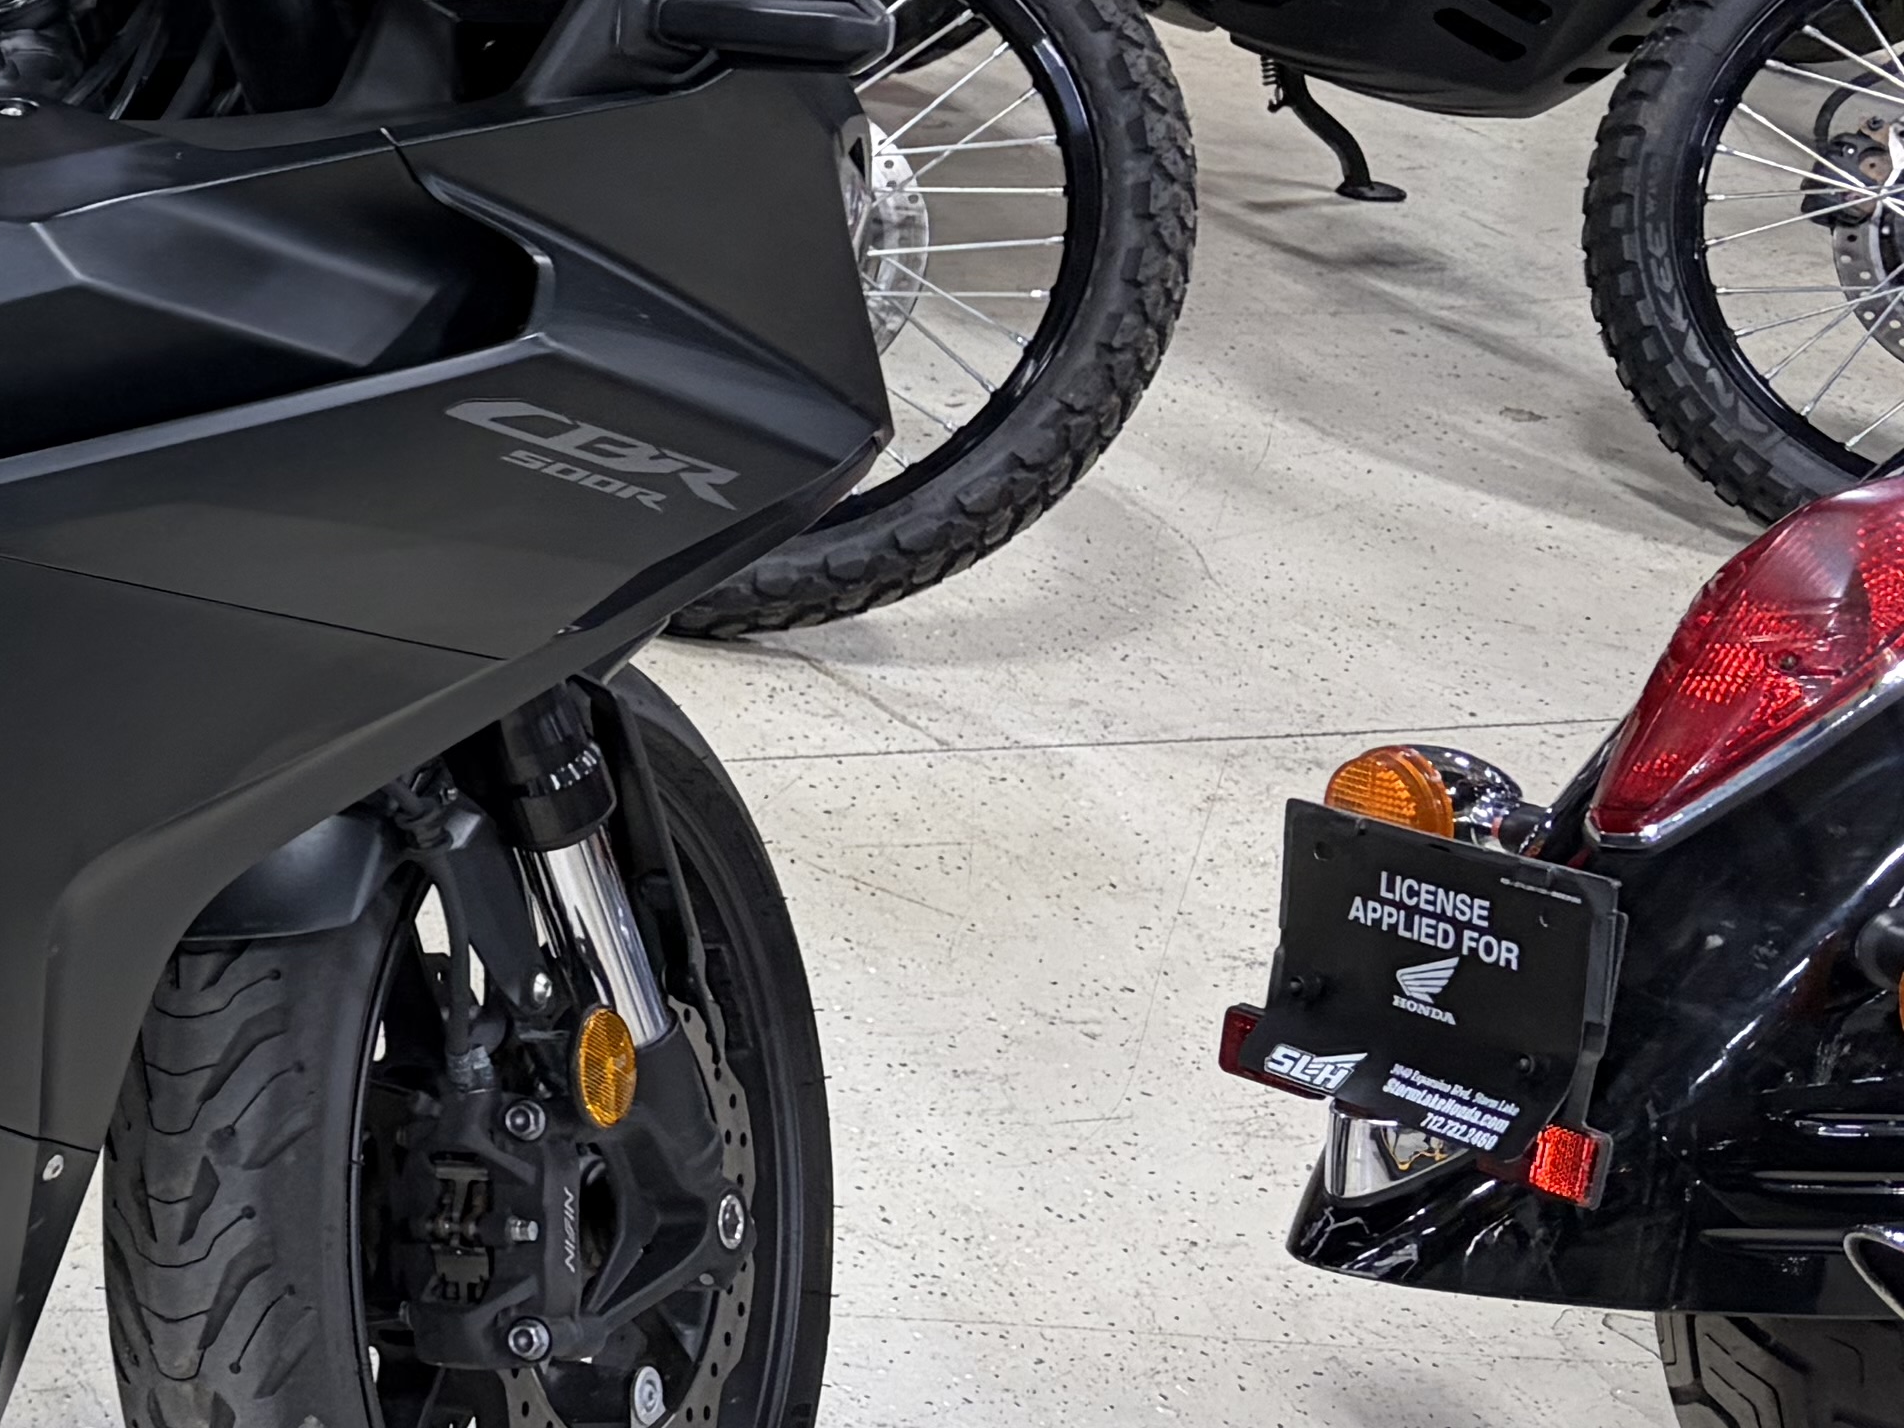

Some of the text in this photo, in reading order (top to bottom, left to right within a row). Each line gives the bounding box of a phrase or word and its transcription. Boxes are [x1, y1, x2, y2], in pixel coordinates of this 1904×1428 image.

[444, 399, 741, 512] CBR
[499, 449, 667, 513] 500R
[1379, 870, 1491, 928] LICENSE
[1347, 895, 1521, 972] APPLIED FOR
[1392, 994, 1457, 1026] HONDA
[1381, 1077, 1510, 1134] StormLakeHonda.com
[563, 1185, 576, 1274] NISSIN
